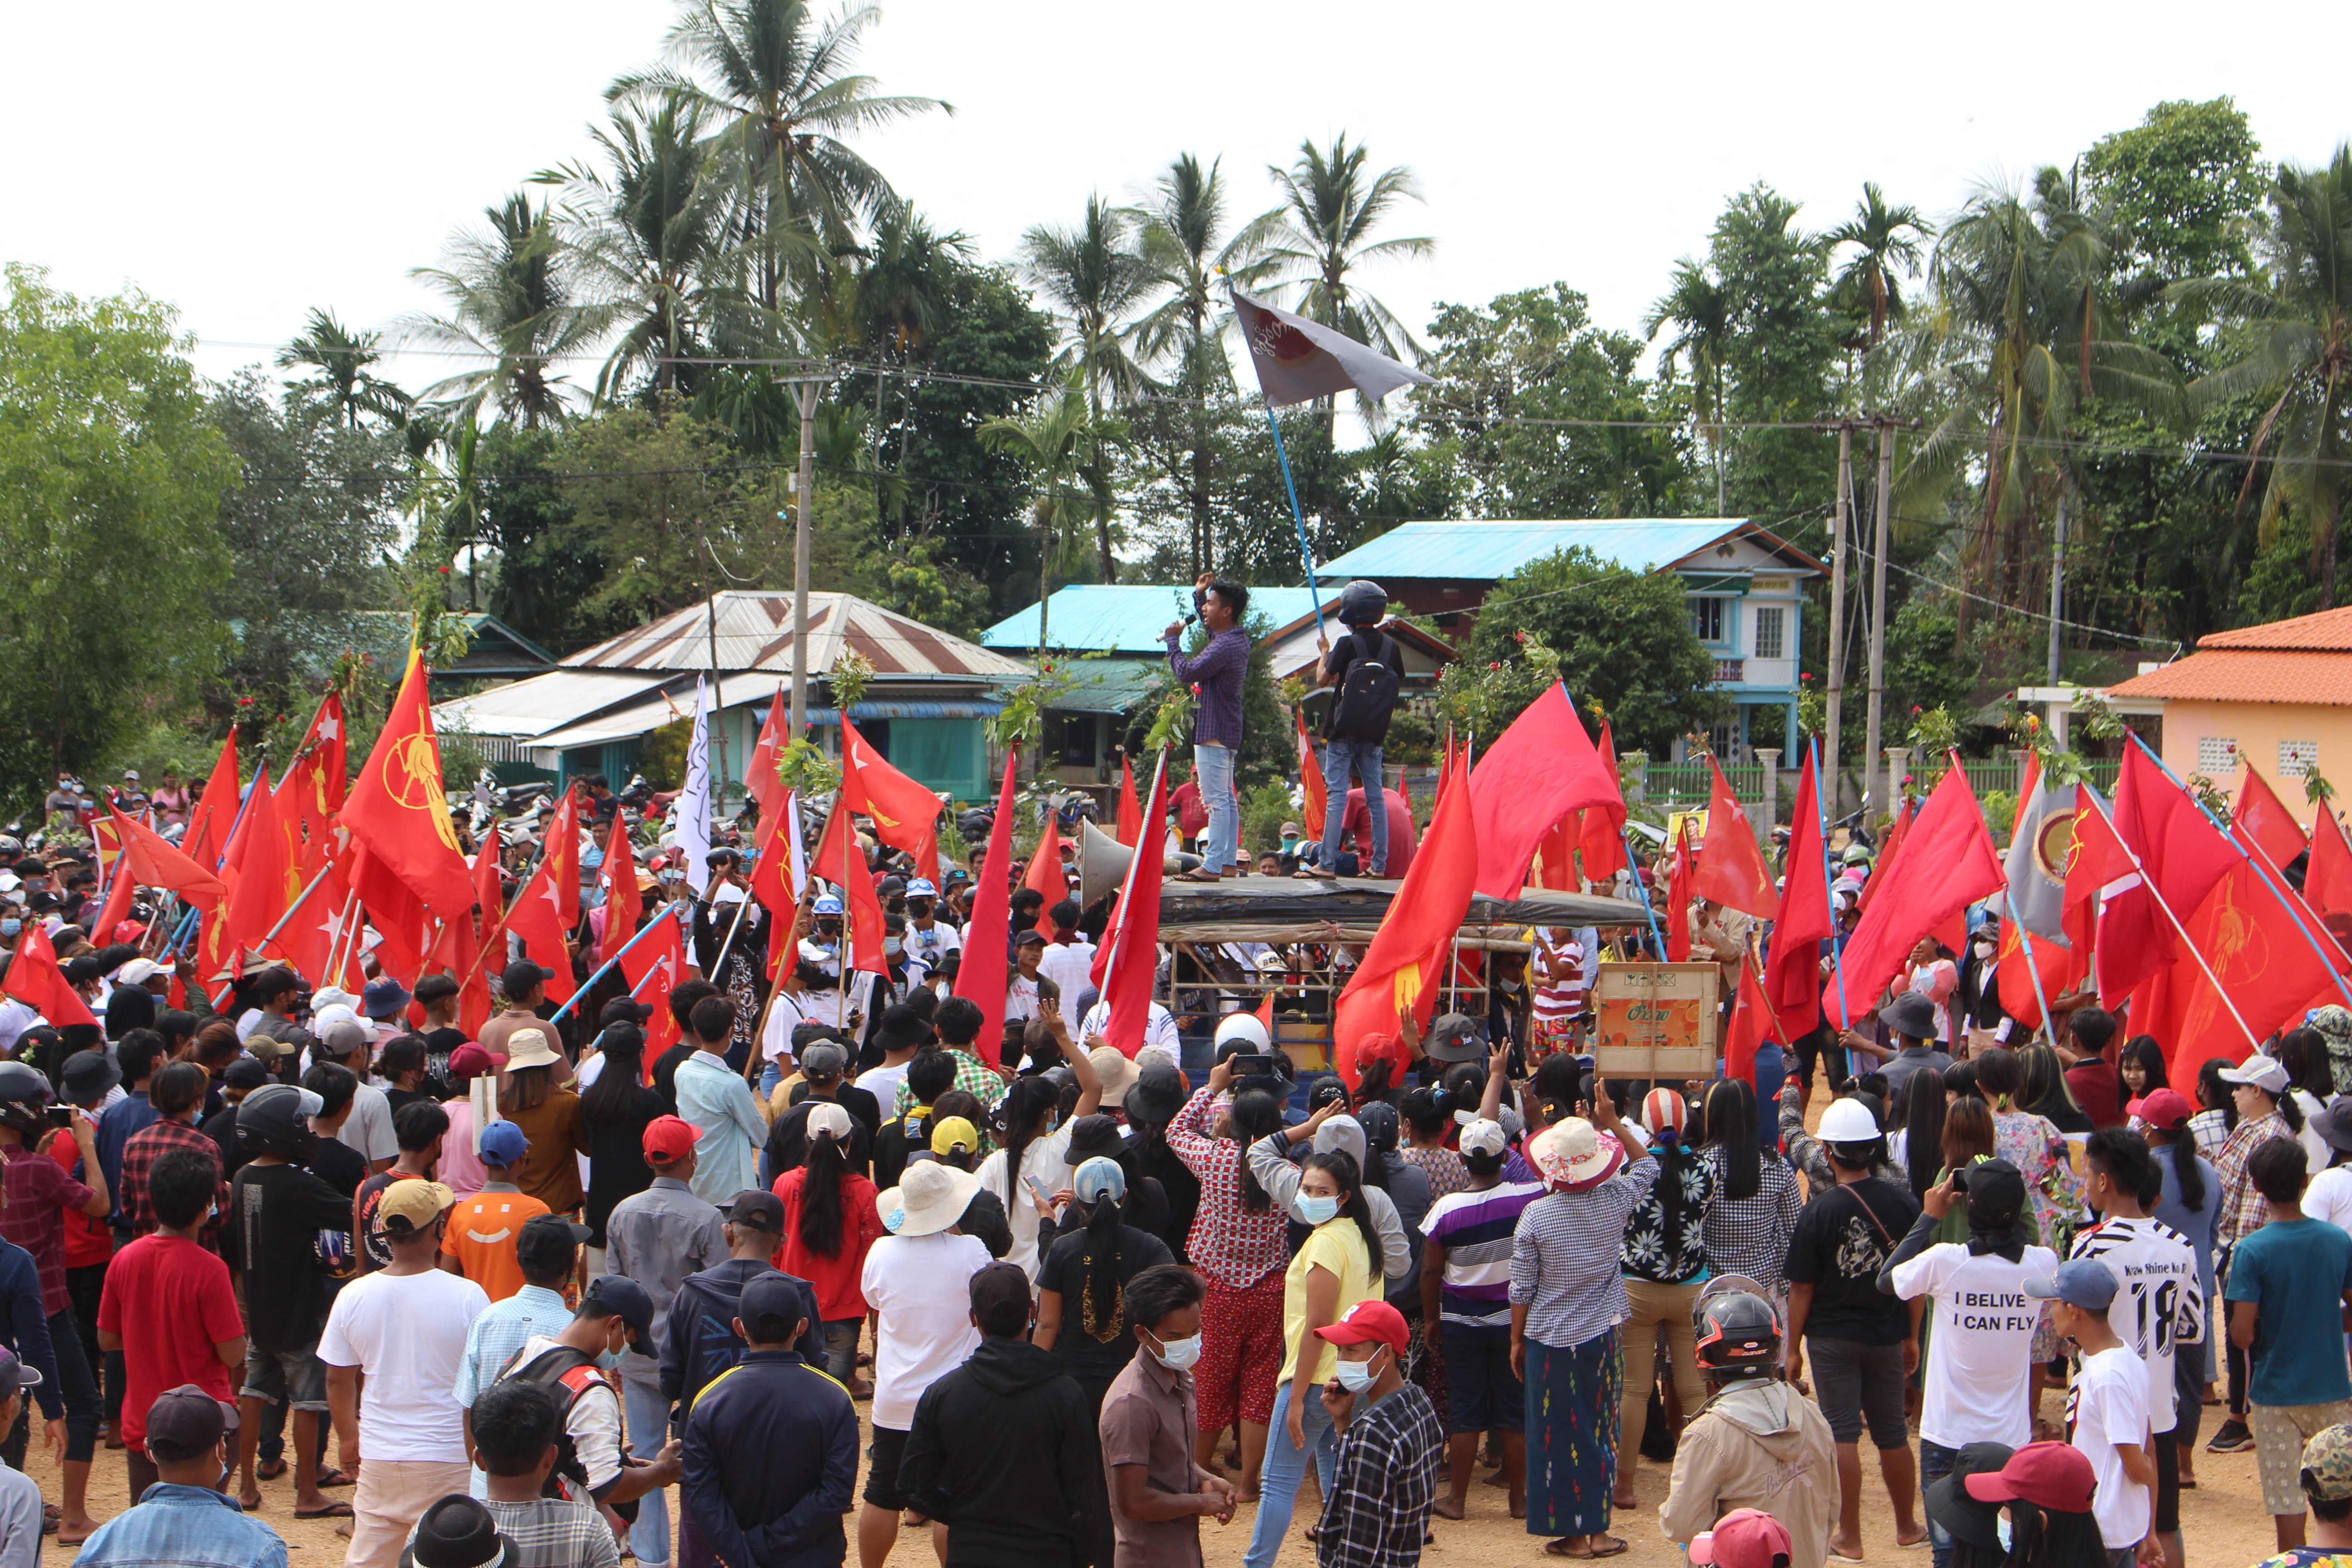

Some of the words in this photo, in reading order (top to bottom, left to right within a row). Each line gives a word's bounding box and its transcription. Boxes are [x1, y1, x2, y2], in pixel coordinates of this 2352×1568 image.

[1263, 957, 1282, 966] BEST
[1955, 1291, 1960, 1304] I
[1966, 1293, 2026, 1307] BELIVE
[1954, 1313, 1958, 1325] I
[1964, 1316, 2000, 1330] CAN
[2007, 1316, 2035, 1330] FLY
[2131, 1280, 2178, 1360] 18
